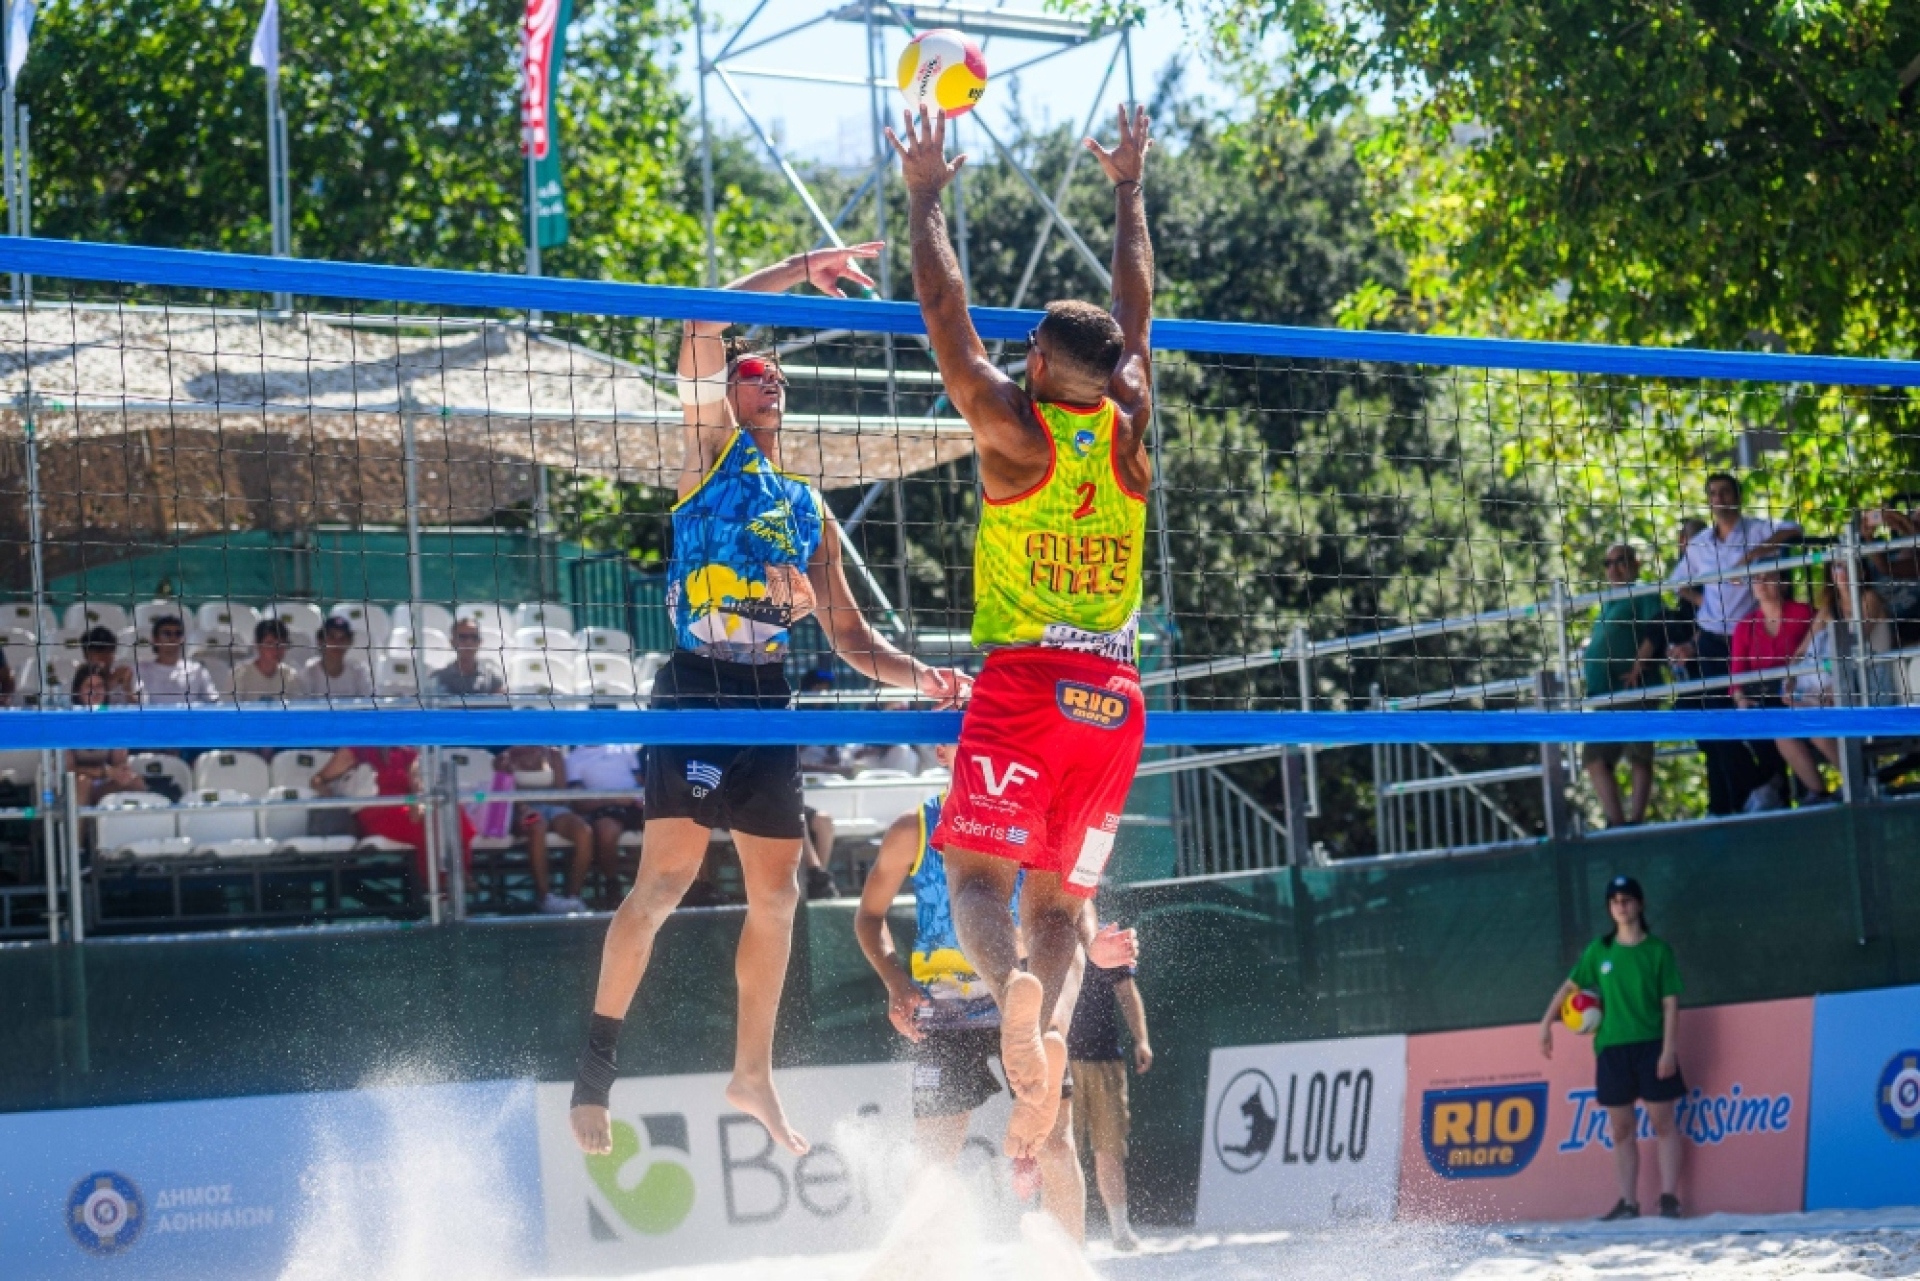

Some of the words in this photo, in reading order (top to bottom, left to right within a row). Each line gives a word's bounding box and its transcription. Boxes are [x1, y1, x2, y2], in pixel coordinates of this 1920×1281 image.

[1073, 481, 1097, 520] 2
[1025, 530, 1134, 564] ATHENS
[1031, 560, 1128, 594] FINALS
[1063, 687, 1124, 717] RIO
[951, 815, 1005, 841] Sideris
[1282, 1068, 1374, 1165] LOCO
[1431, 1096, 1535, 1147] RIO
[1448, 1145, 1514, 1167] mare
[156, 1184, 233, 1209] ΔΗΜΟΣ
